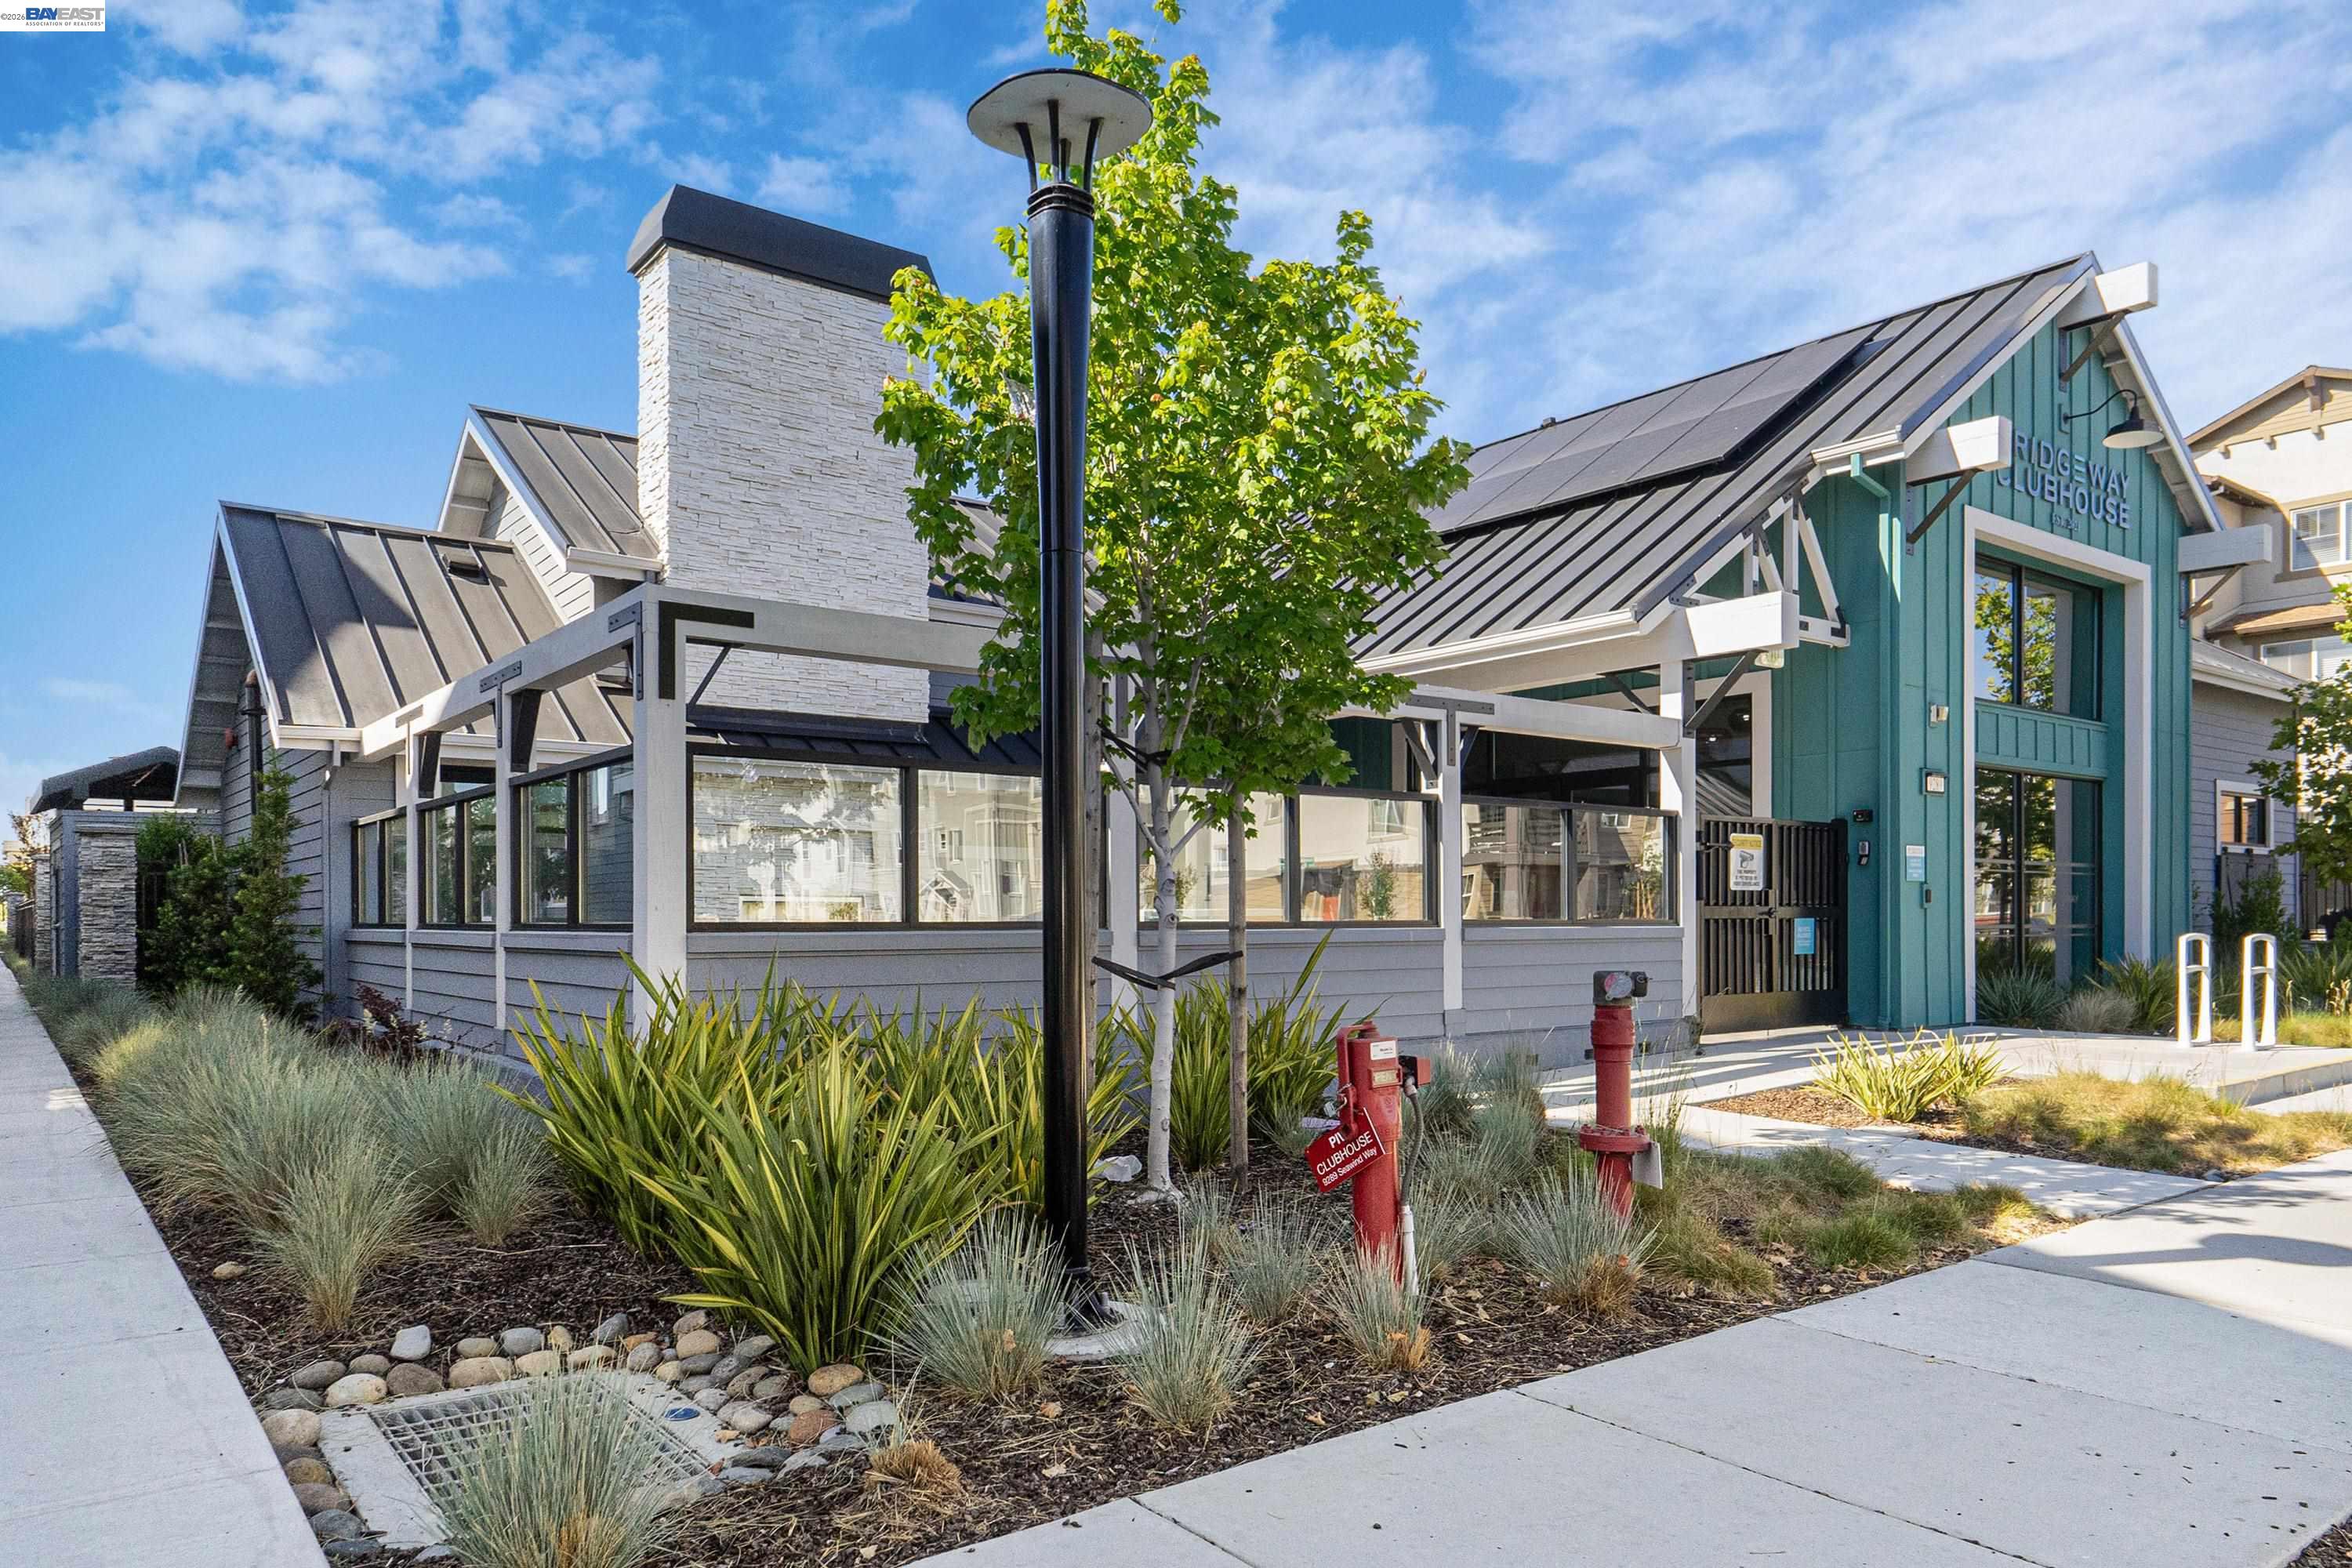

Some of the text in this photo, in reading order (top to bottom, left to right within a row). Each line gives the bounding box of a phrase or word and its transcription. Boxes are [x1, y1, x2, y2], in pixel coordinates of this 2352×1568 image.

[2016, 434, 2130, 499] RIDGEWAY
[1317, 1131, 1374, 1175] CLUBHOUSE
[1337, 1154, 1363, 1176] Seawind
[1362, 1146, 1377, 1160] Way
